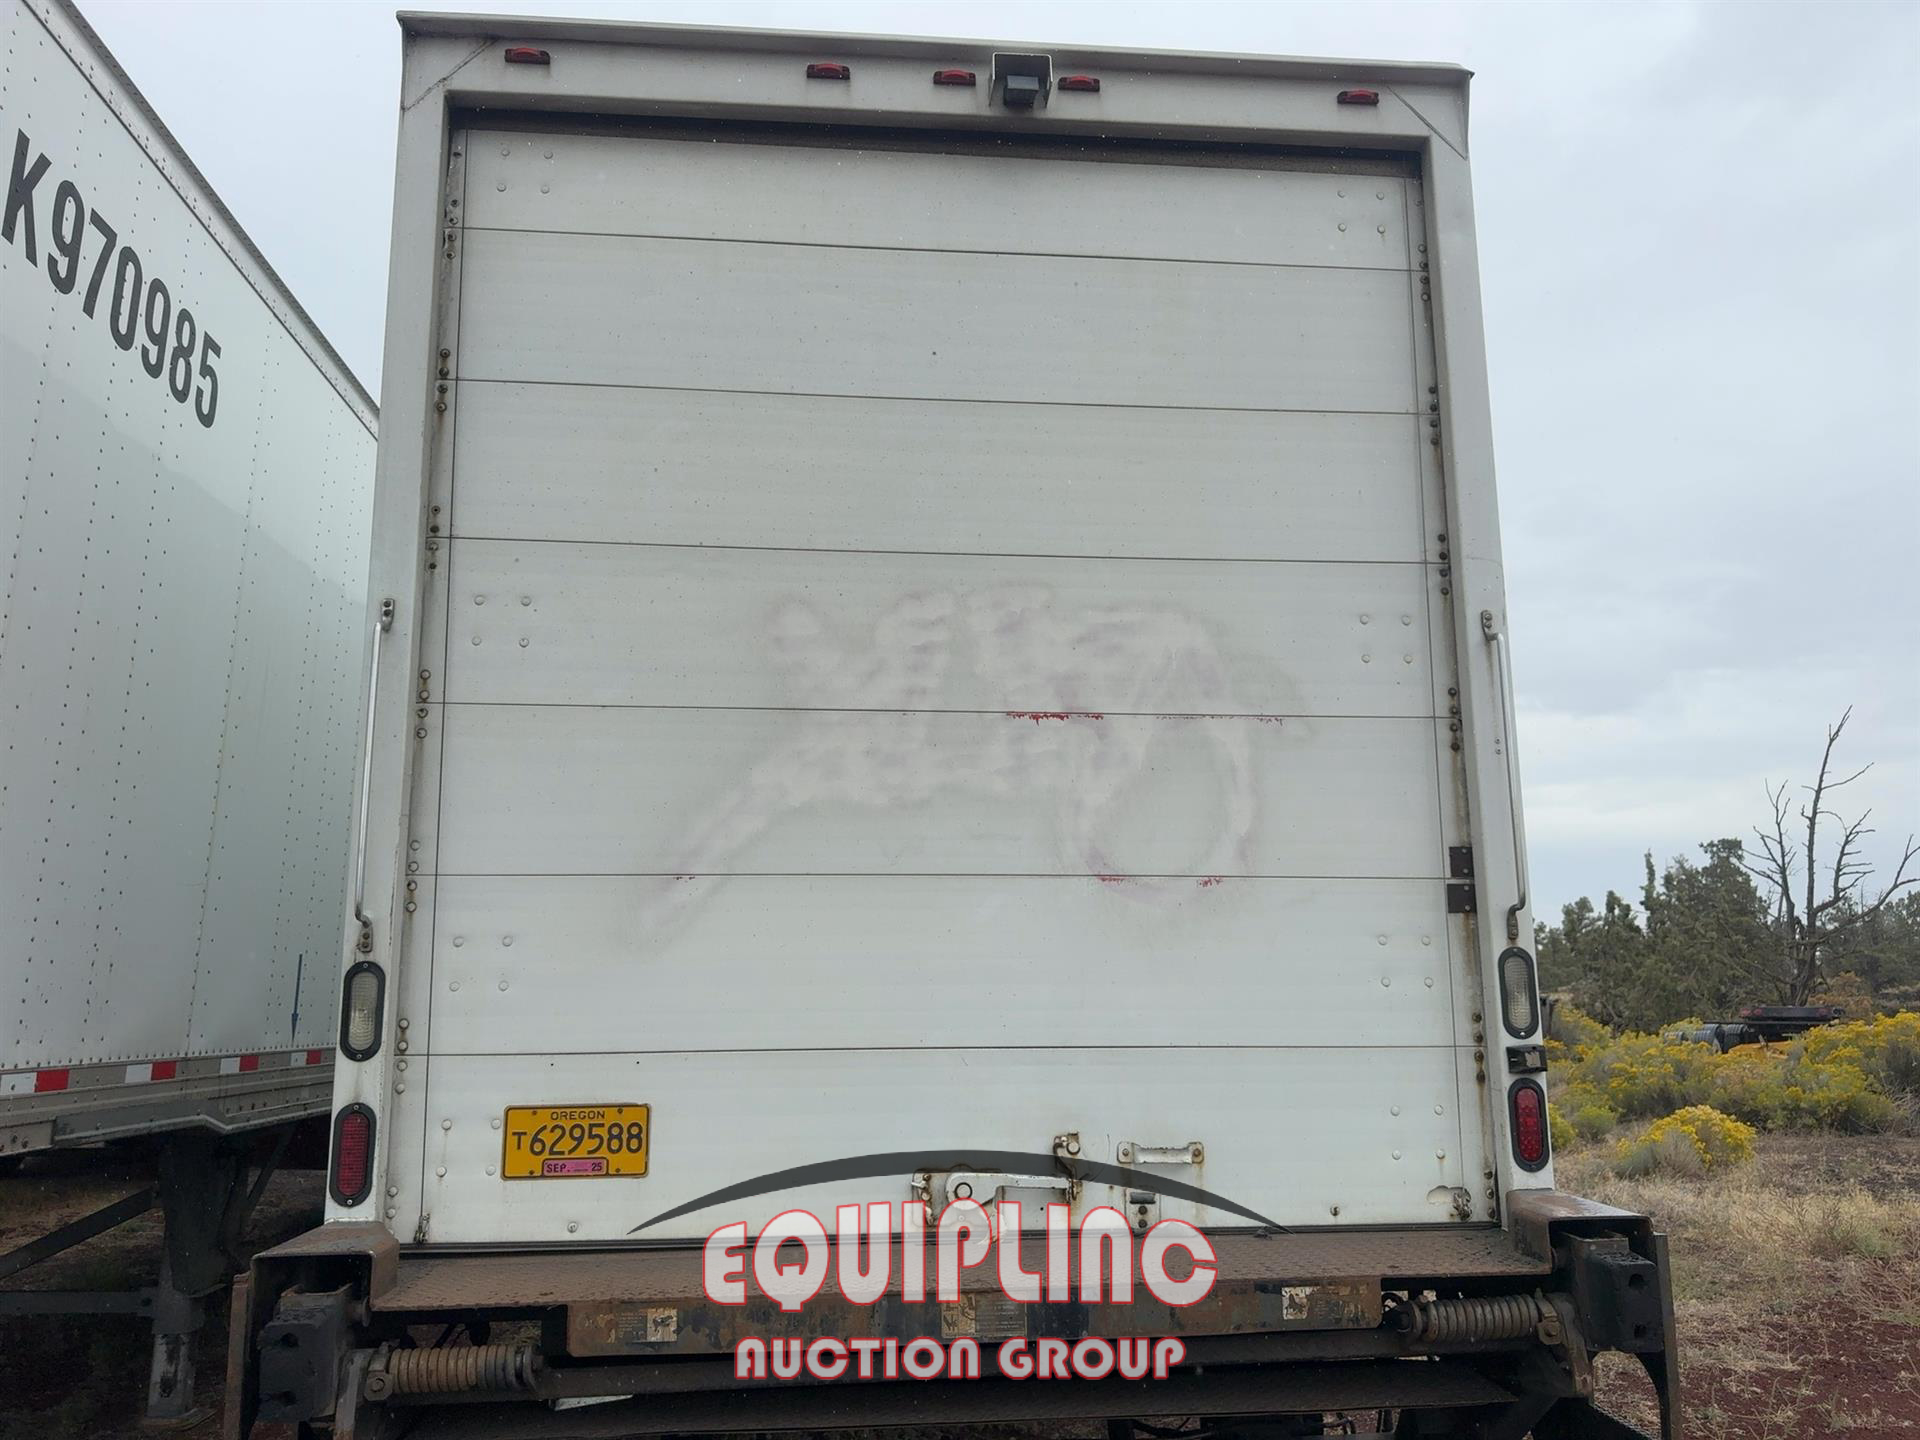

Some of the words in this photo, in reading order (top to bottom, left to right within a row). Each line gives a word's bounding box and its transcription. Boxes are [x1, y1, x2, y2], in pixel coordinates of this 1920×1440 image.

[1, 128, 222, 429] K970985
[550, 1110, 606, 1121] OREGON
[512, 1121, 644, 1156] T629588
[591, 1162, 603, 1172] 25
